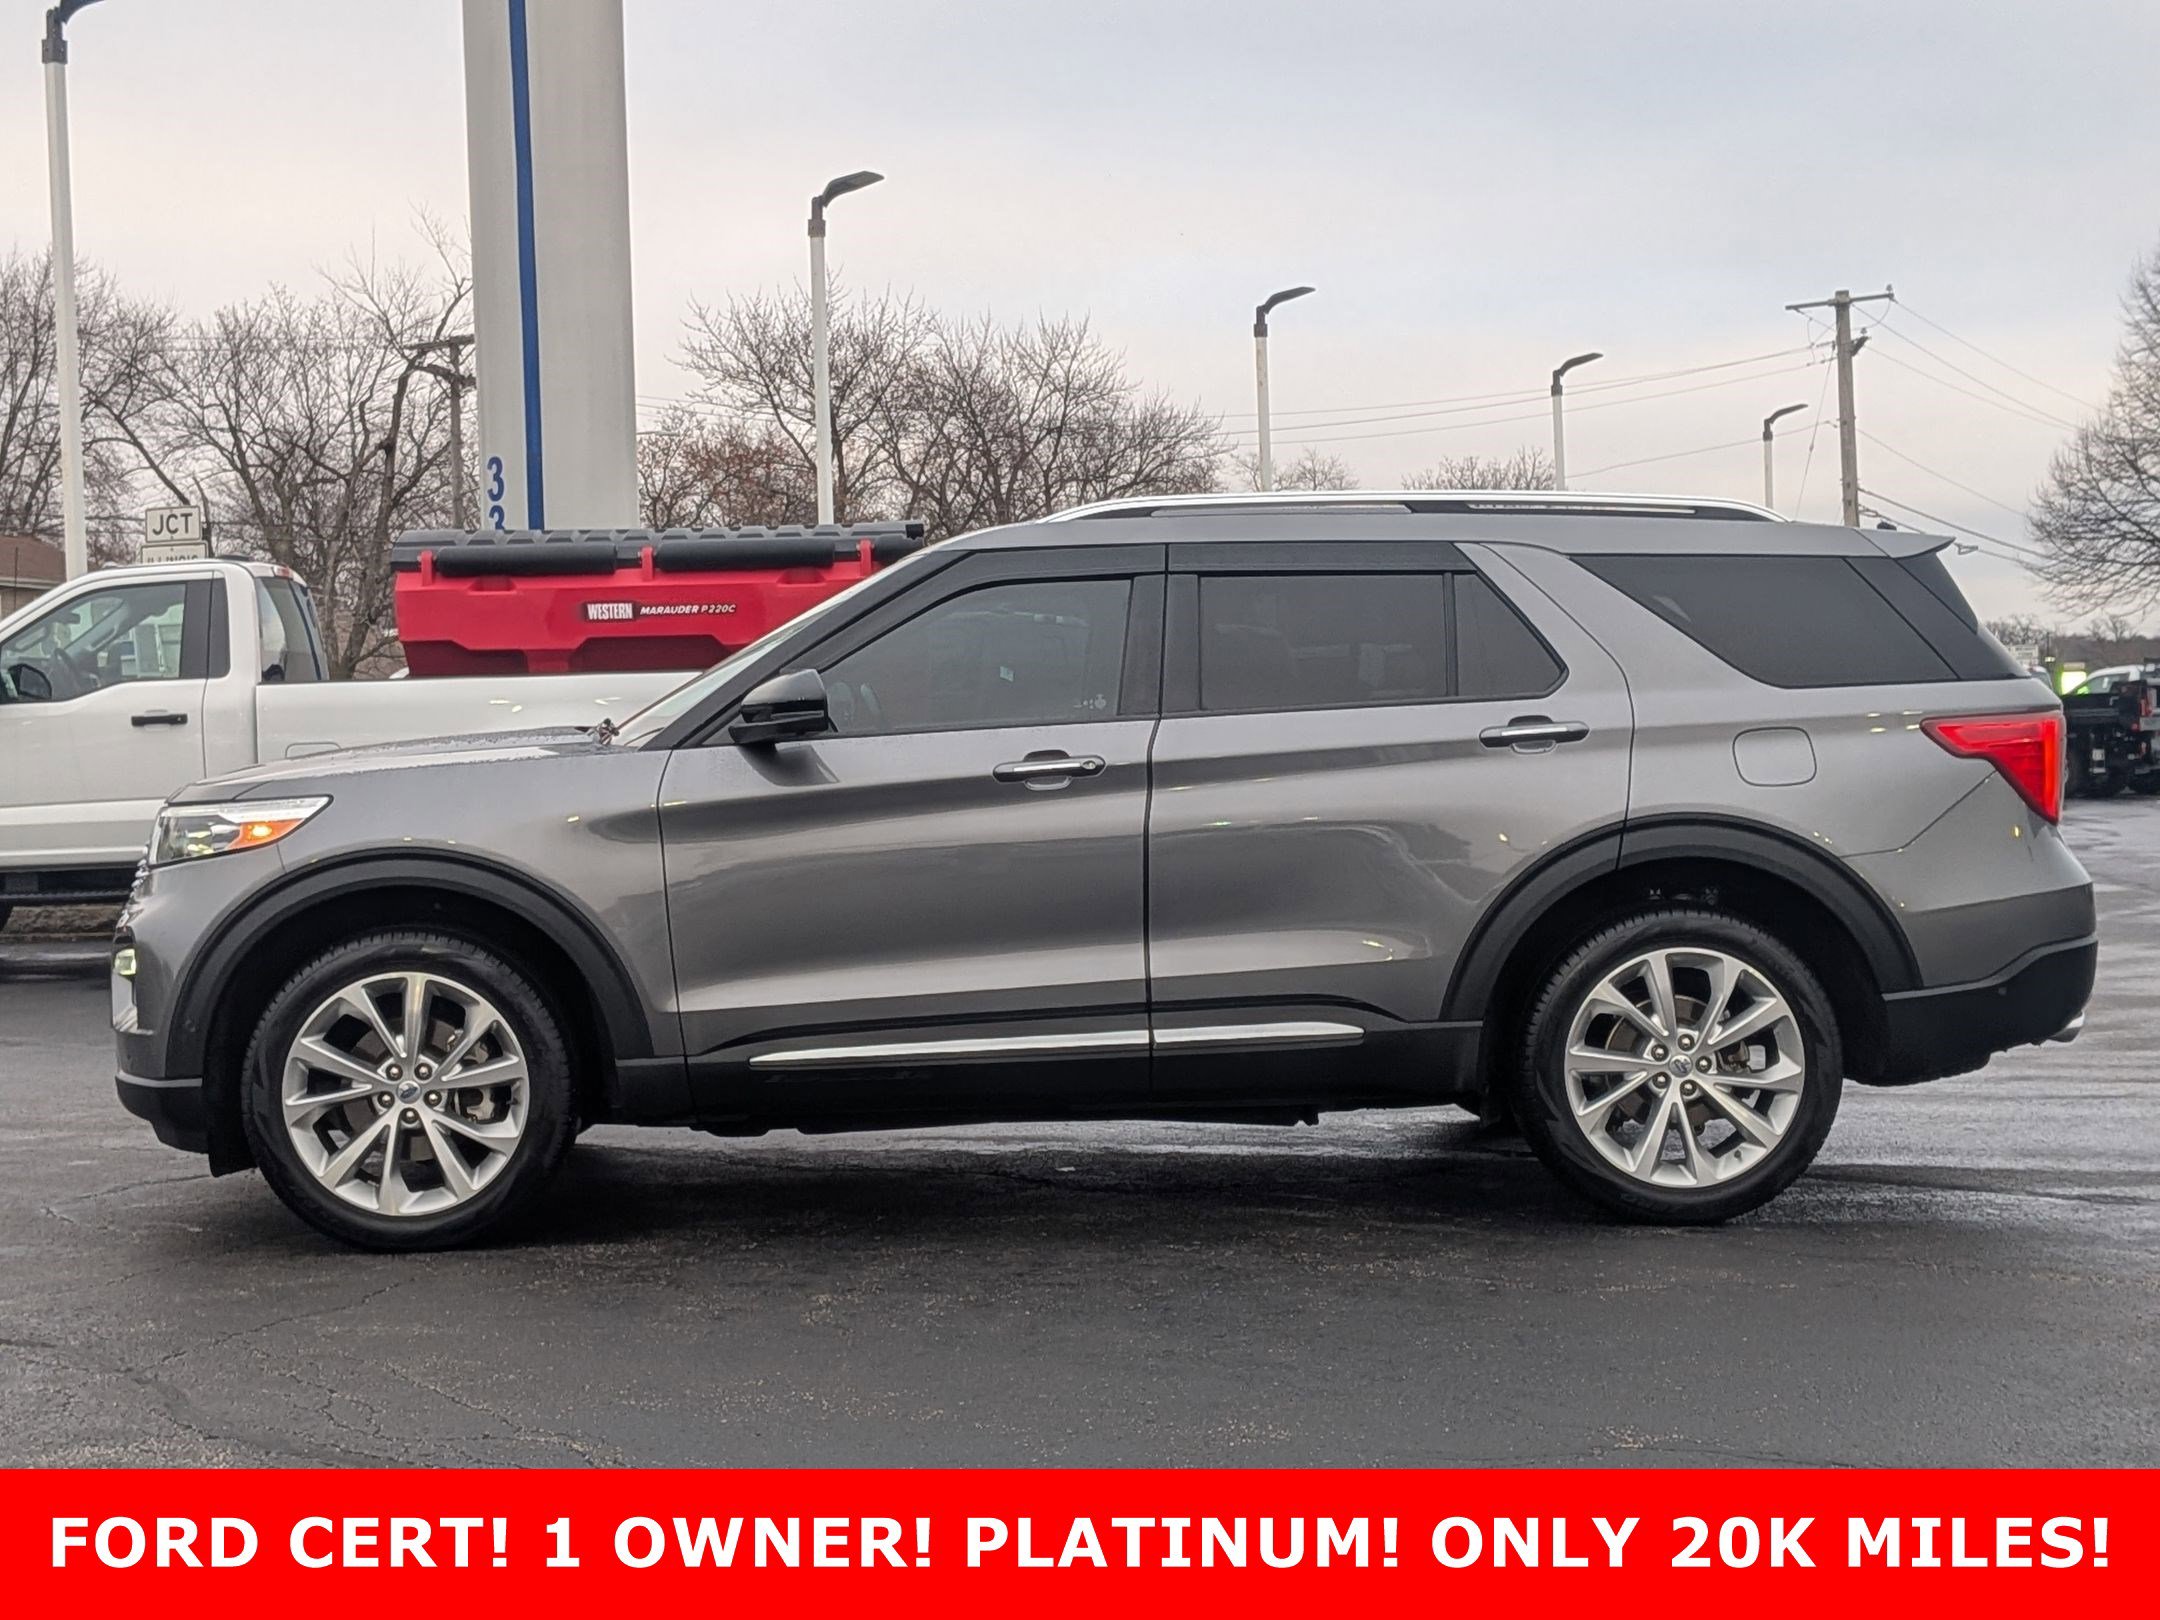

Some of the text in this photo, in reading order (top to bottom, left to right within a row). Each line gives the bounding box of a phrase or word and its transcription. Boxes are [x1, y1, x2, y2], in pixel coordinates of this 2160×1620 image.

[152, 513, 193, 535] JCT
[587, 603, 633, 620] WESTERN
[640, 605, 699, 615] MARAUDER
